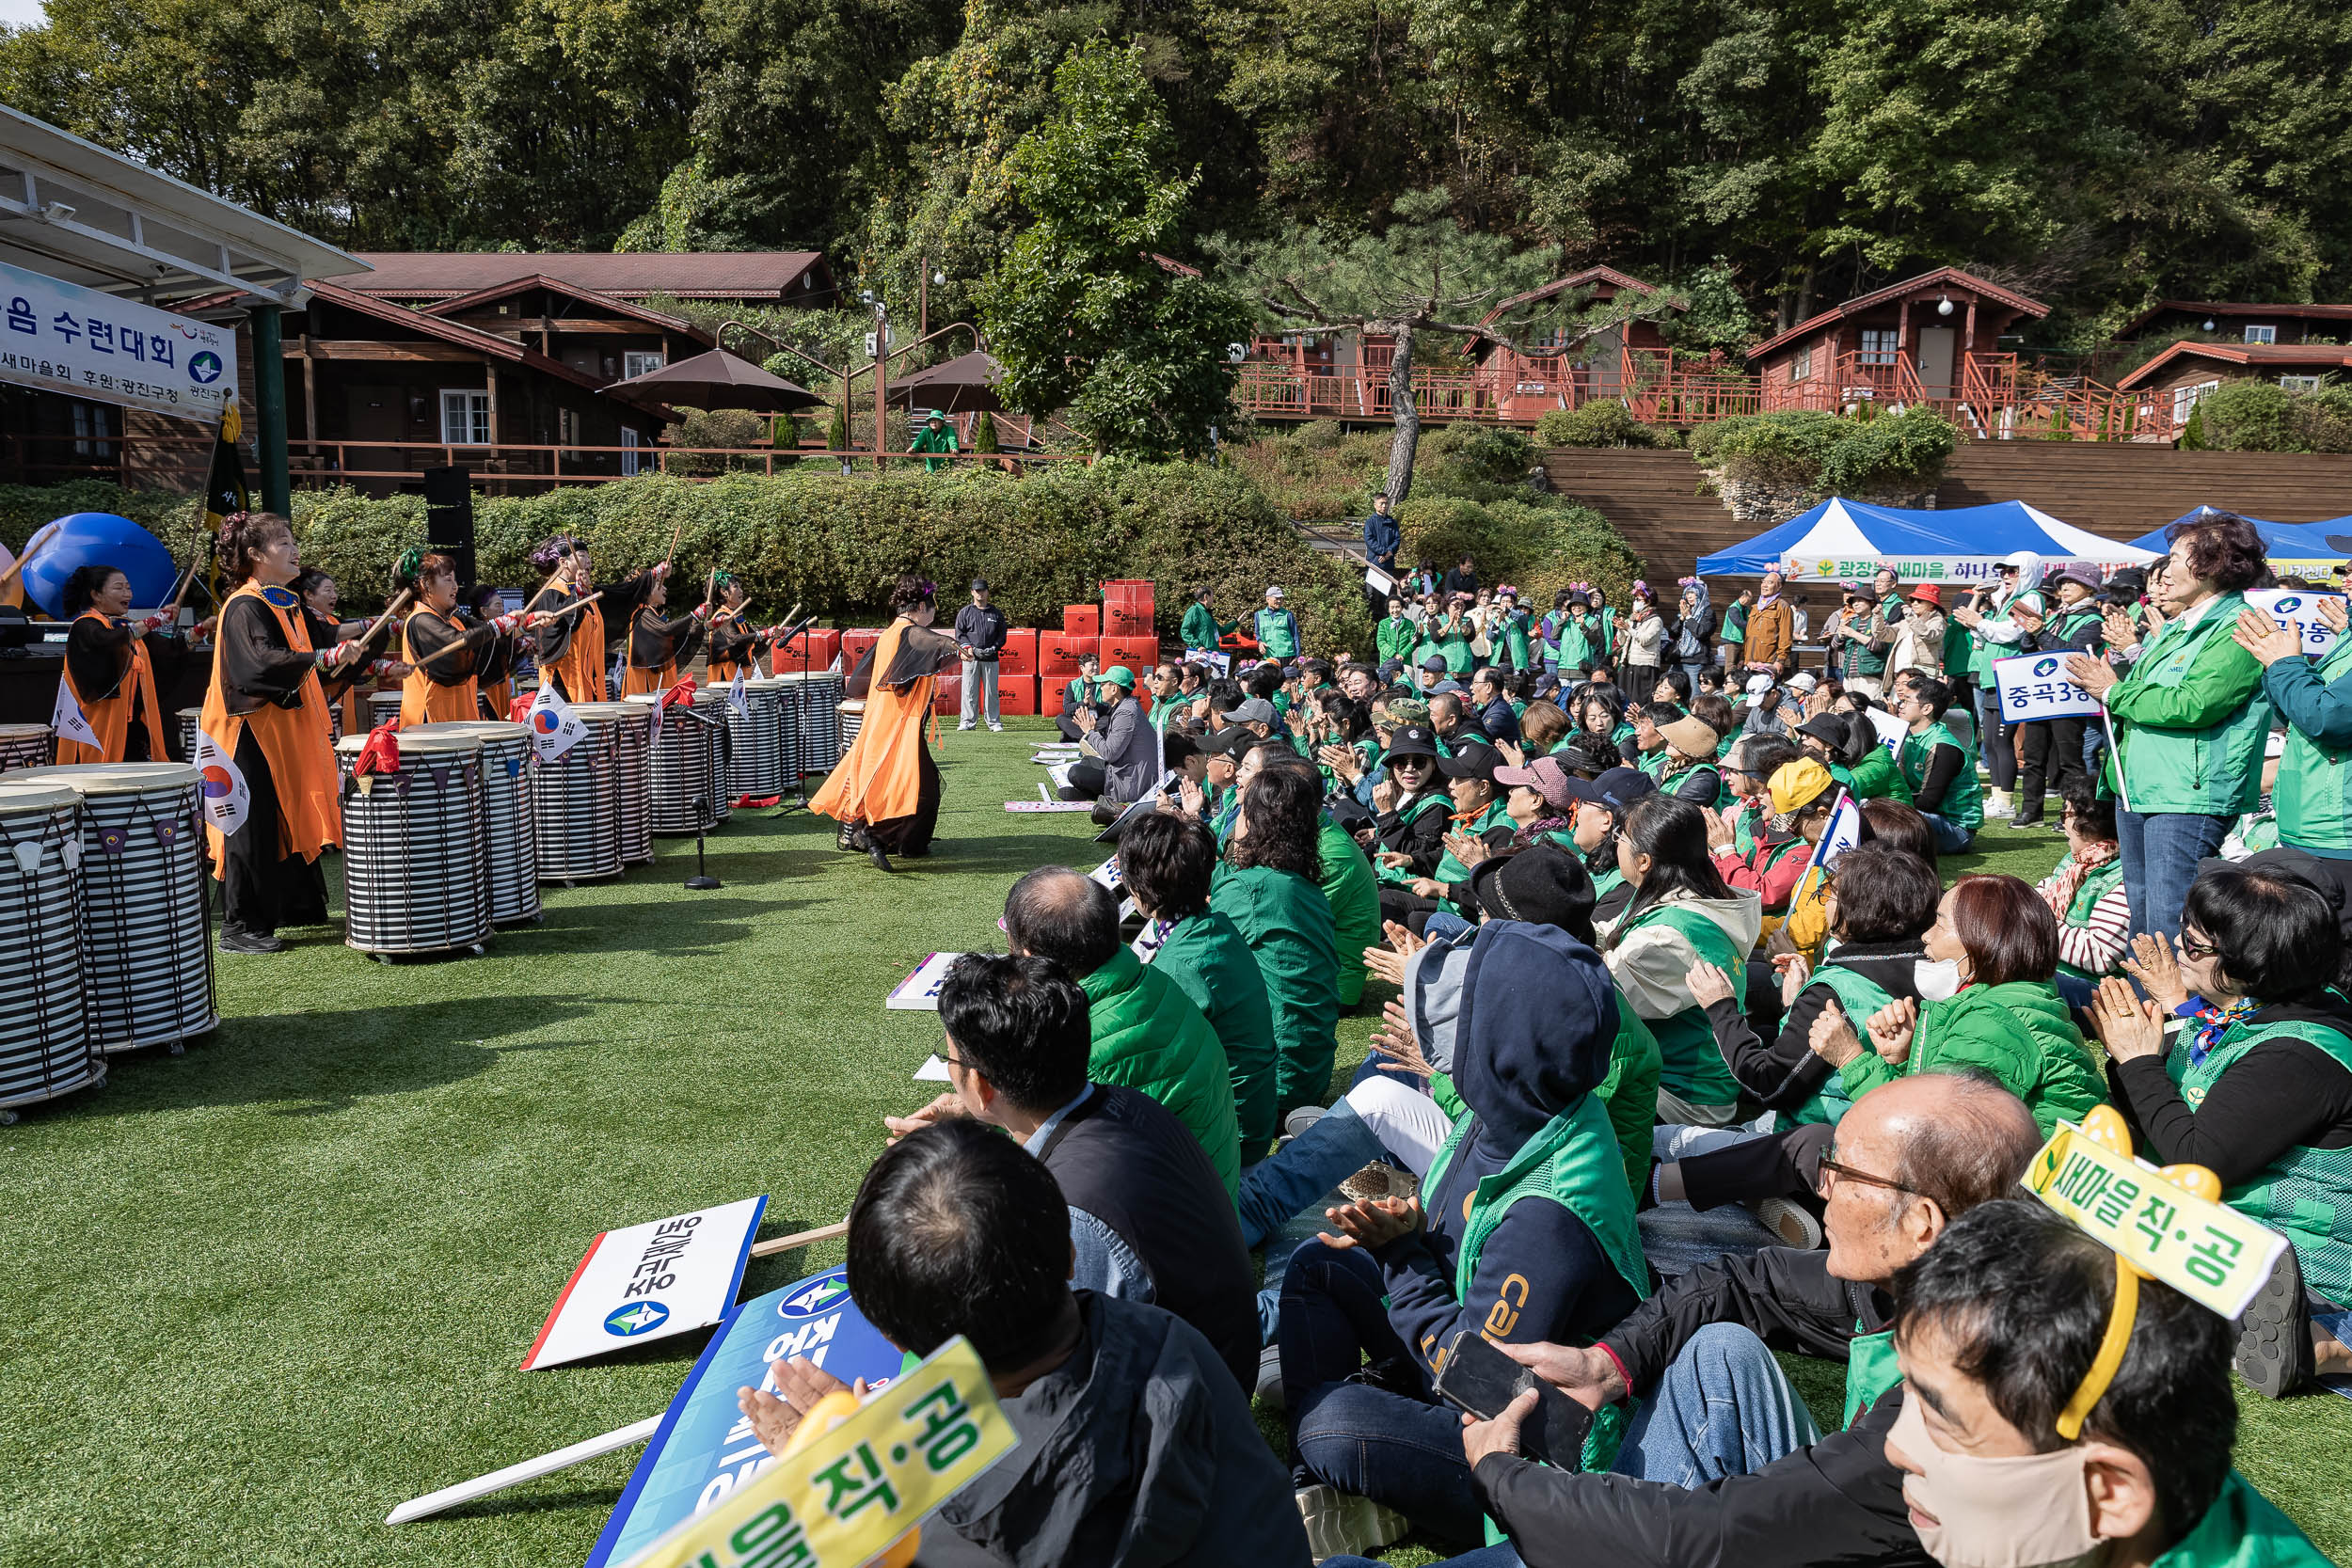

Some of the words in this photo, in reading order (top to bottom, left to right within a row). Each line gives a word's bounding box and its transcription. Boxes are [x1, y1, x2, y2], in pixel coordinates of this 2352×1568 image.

[0, 295, 38, 336] 음
[53, 311, 175, 369] 수련대회
[1, 352, 72, 380] 새마을회
[83, 370, 179, 404] 후원:광진구청
[189, 385, 220, 401] 광진구
[2280, 563, 2333, 580] 나가신다
[623, 1216, 703, 1299] 중곡제2동
